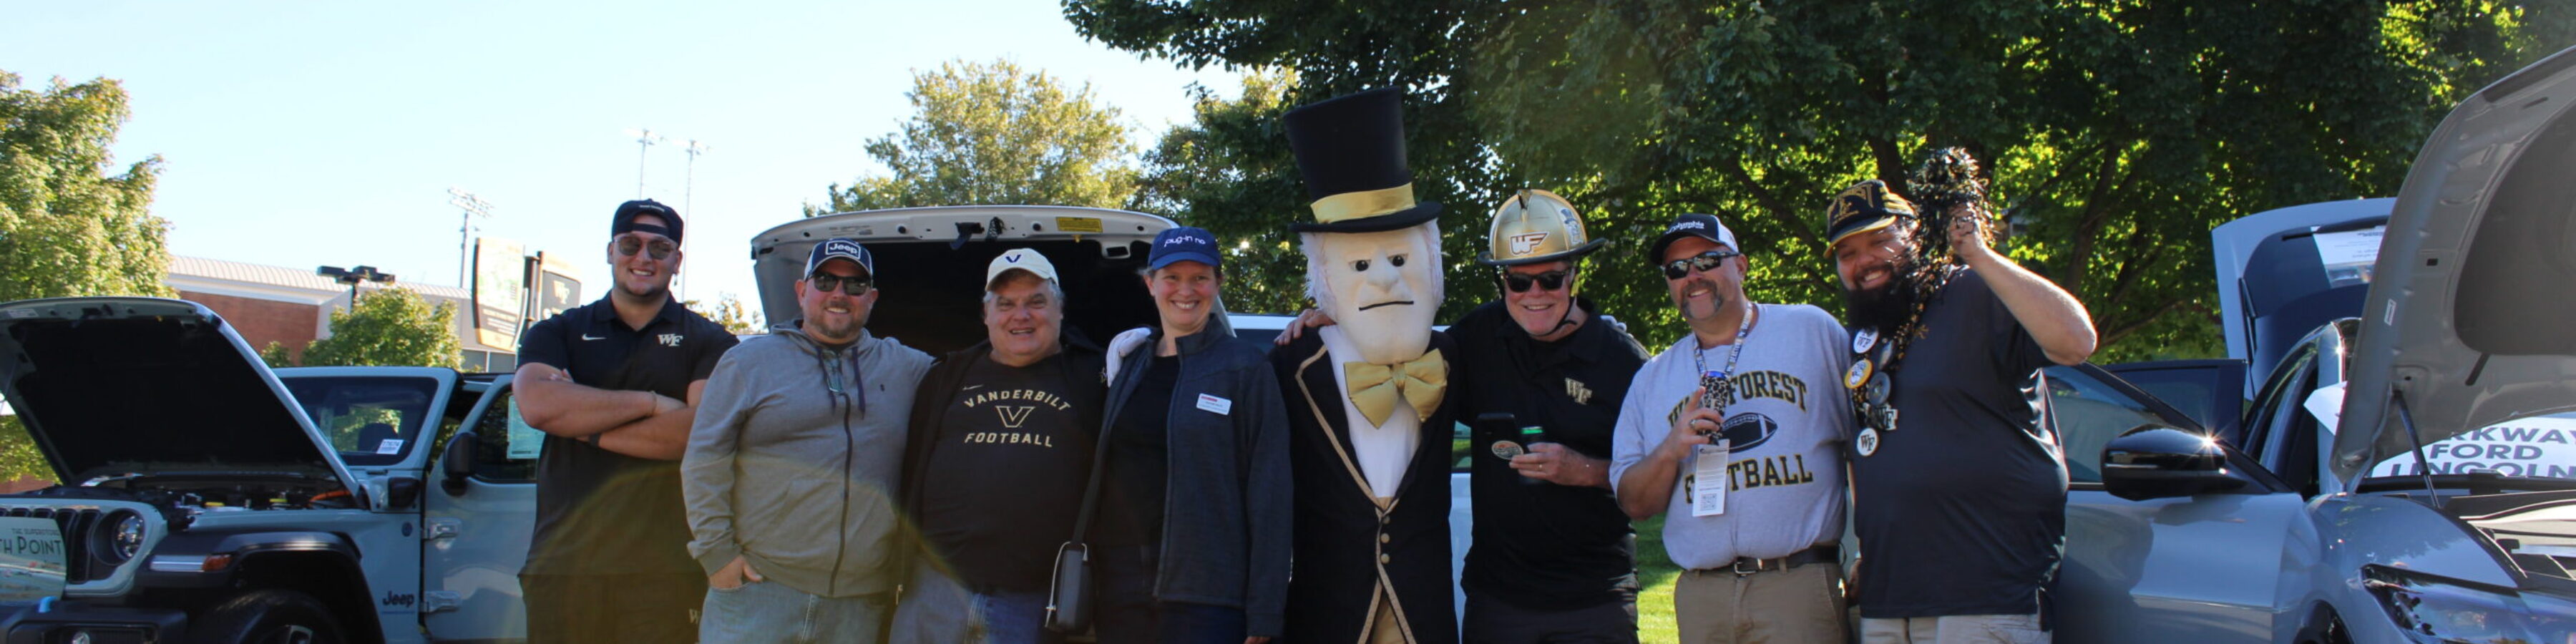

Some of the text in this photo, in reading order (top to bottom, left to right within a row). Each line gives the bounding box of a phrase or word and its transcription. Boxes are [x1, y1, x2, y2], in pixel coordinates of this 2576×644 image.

[829, 243, 858, 255] Jeep
[1005, 254, 1021, 263] V
[658, 333, 683, 347] WF
[964, 389, 1071, 411] VANDERBILT
[1565, 377, 1593, 405] WF
[1727, 370, 1807, 413] FOREST
[995, 405, 1035, 428] V
[965, 432, 1053, 447] FOOTBALL
[1860, 434, 1875, 451] WF
[2430, 444, 2543, 459] FORD
[1684, 454, 1814, 504] FTBALL
[0, 536, 61, 555] H POINT
[383, 590, 414, 608] Jeep
